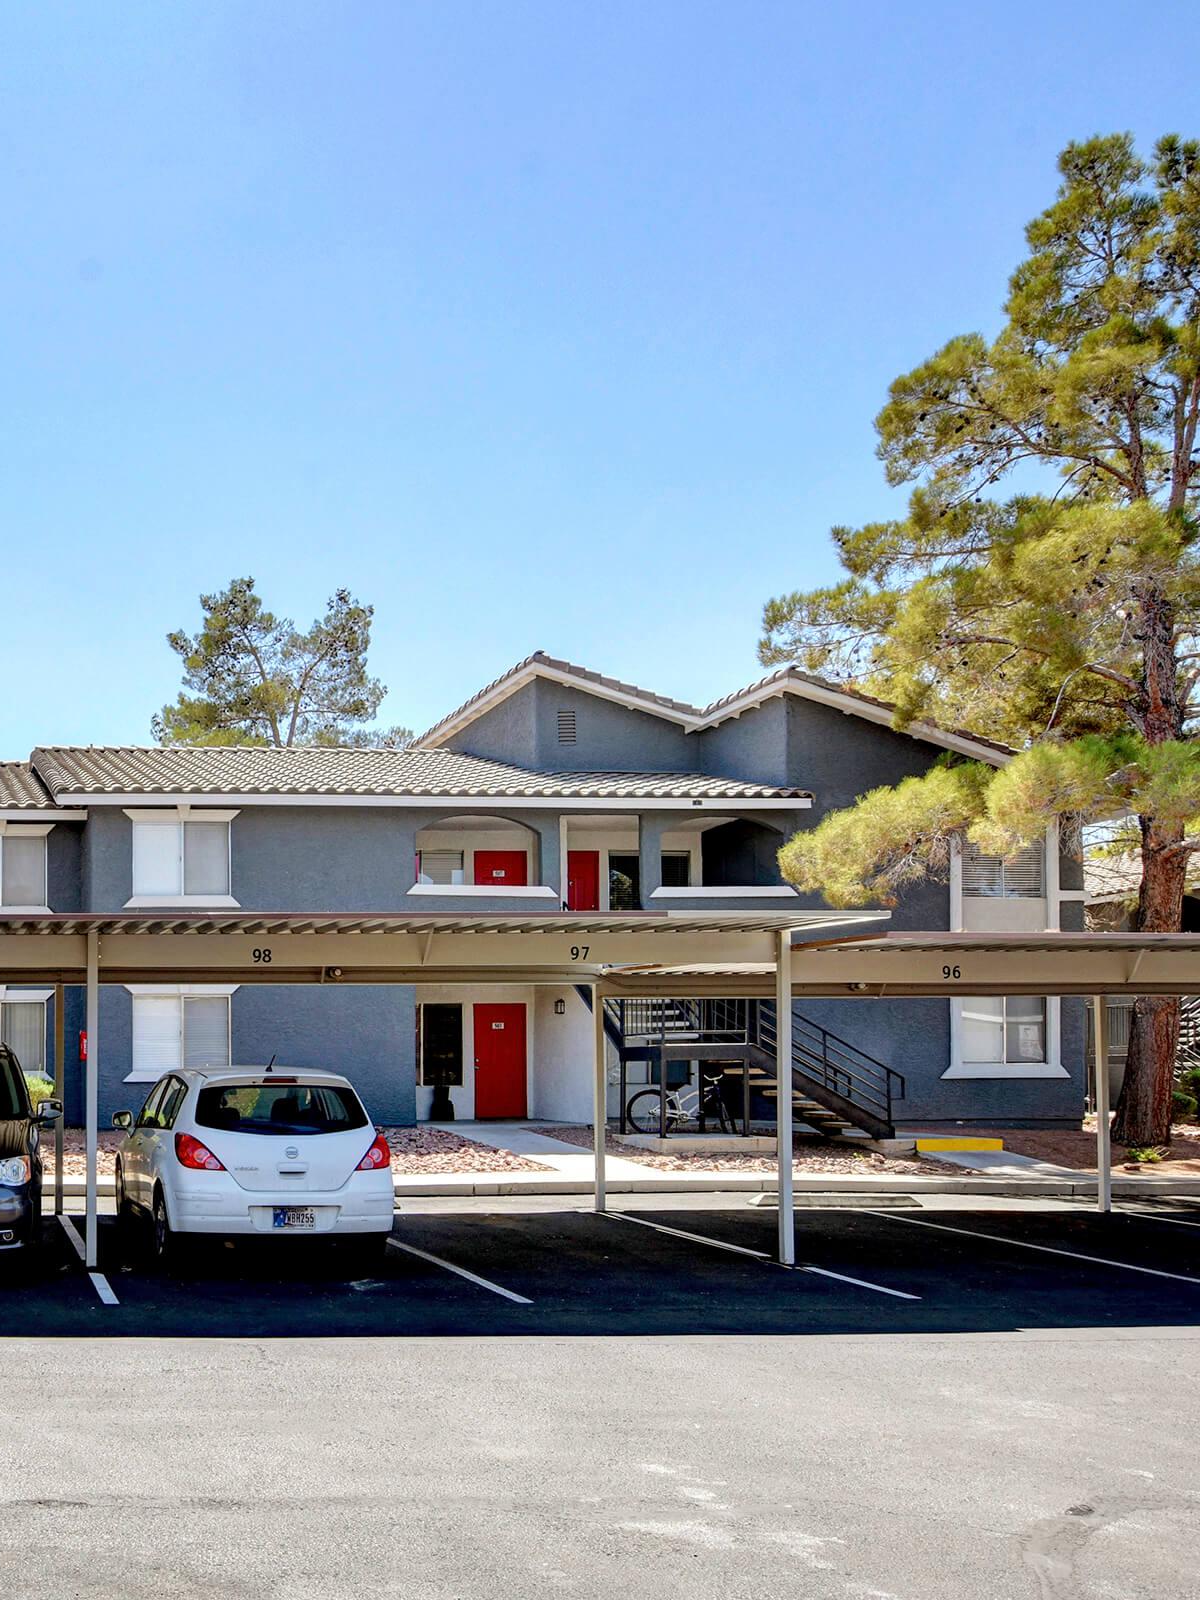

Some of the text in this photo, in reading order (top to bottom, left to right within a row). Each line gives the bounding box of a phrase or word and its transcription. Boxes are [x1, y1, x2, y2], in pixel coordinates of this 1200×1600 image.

[252, 948, 272, 963] 98
[570, 946, 590, 961] 97
[942, 965, 961, 980] 96
